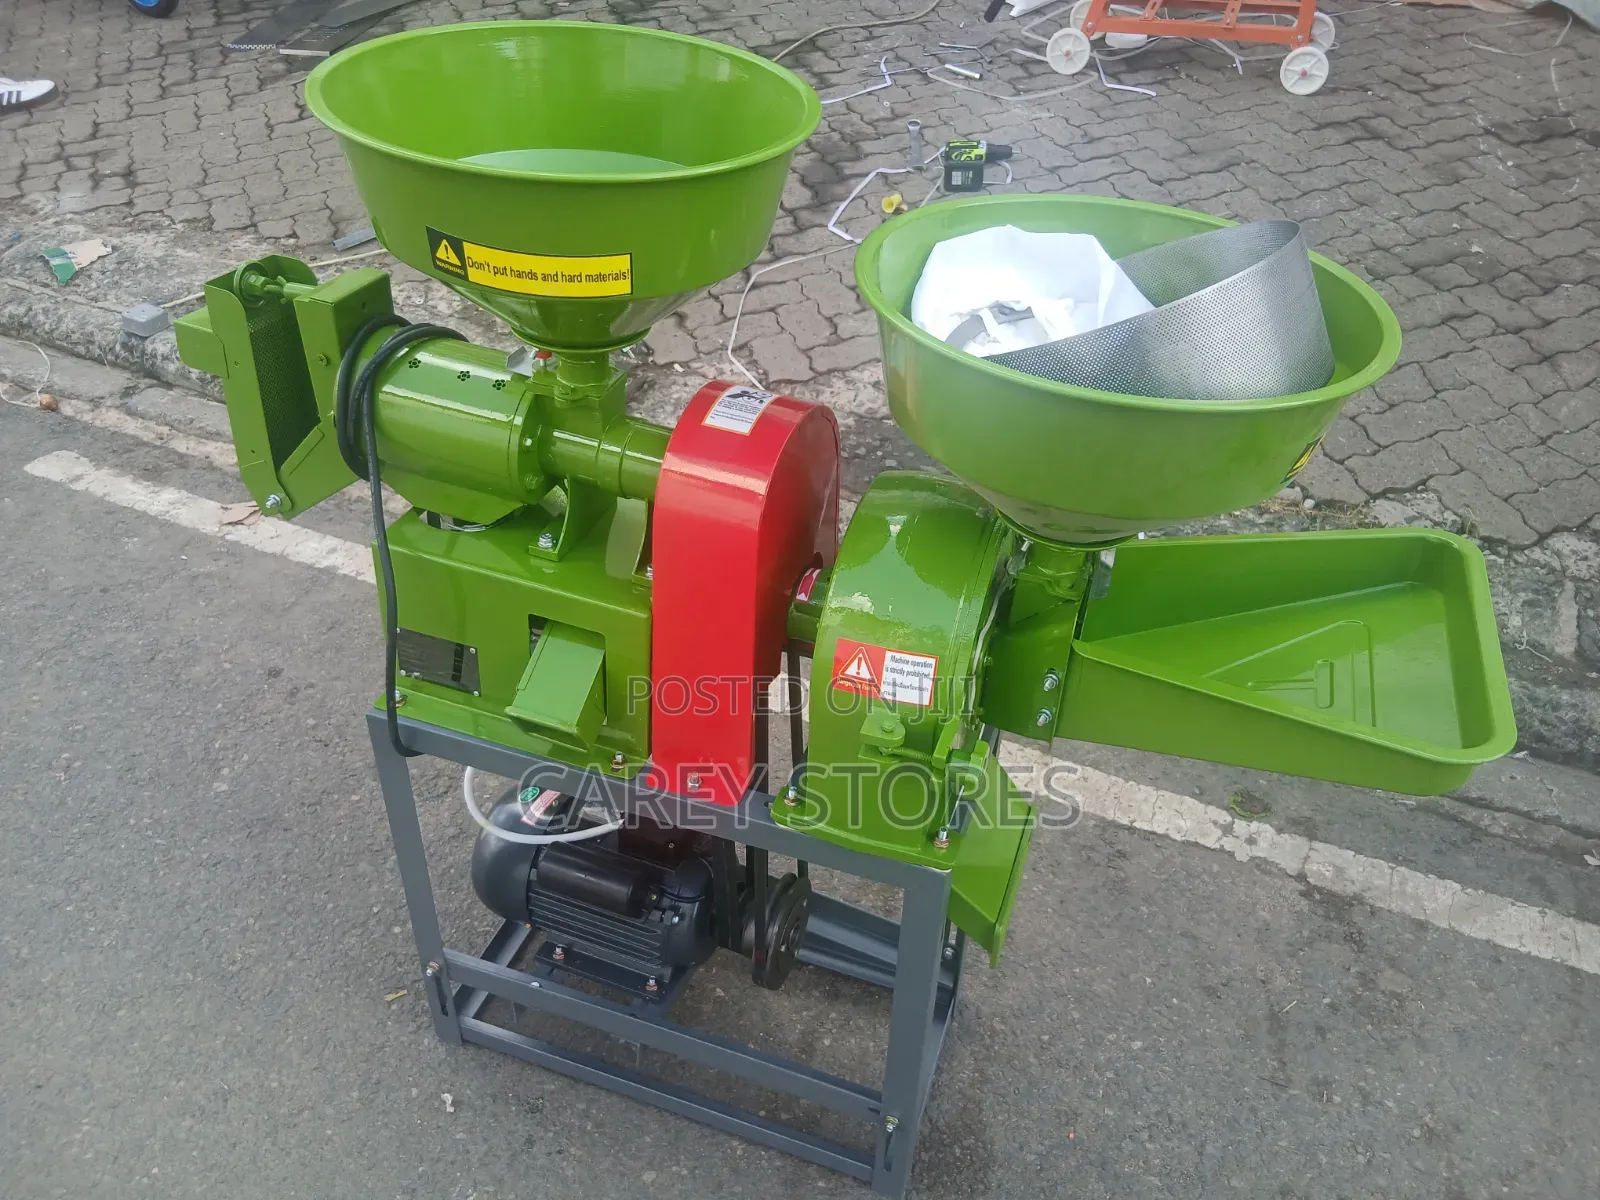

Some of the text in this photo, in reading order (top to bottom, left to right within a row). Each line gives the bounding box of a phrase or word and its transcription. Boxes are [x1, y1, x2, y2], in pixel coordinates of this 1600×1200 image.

[435, 259, 465, 275] WARNING
[467, 256, 630, 284] Don't put hands and hard materials!
[890, 654, 933, 669] Machine operation
[884, 664, 889, 673] is
[889, 666, 906, 677] strictly
